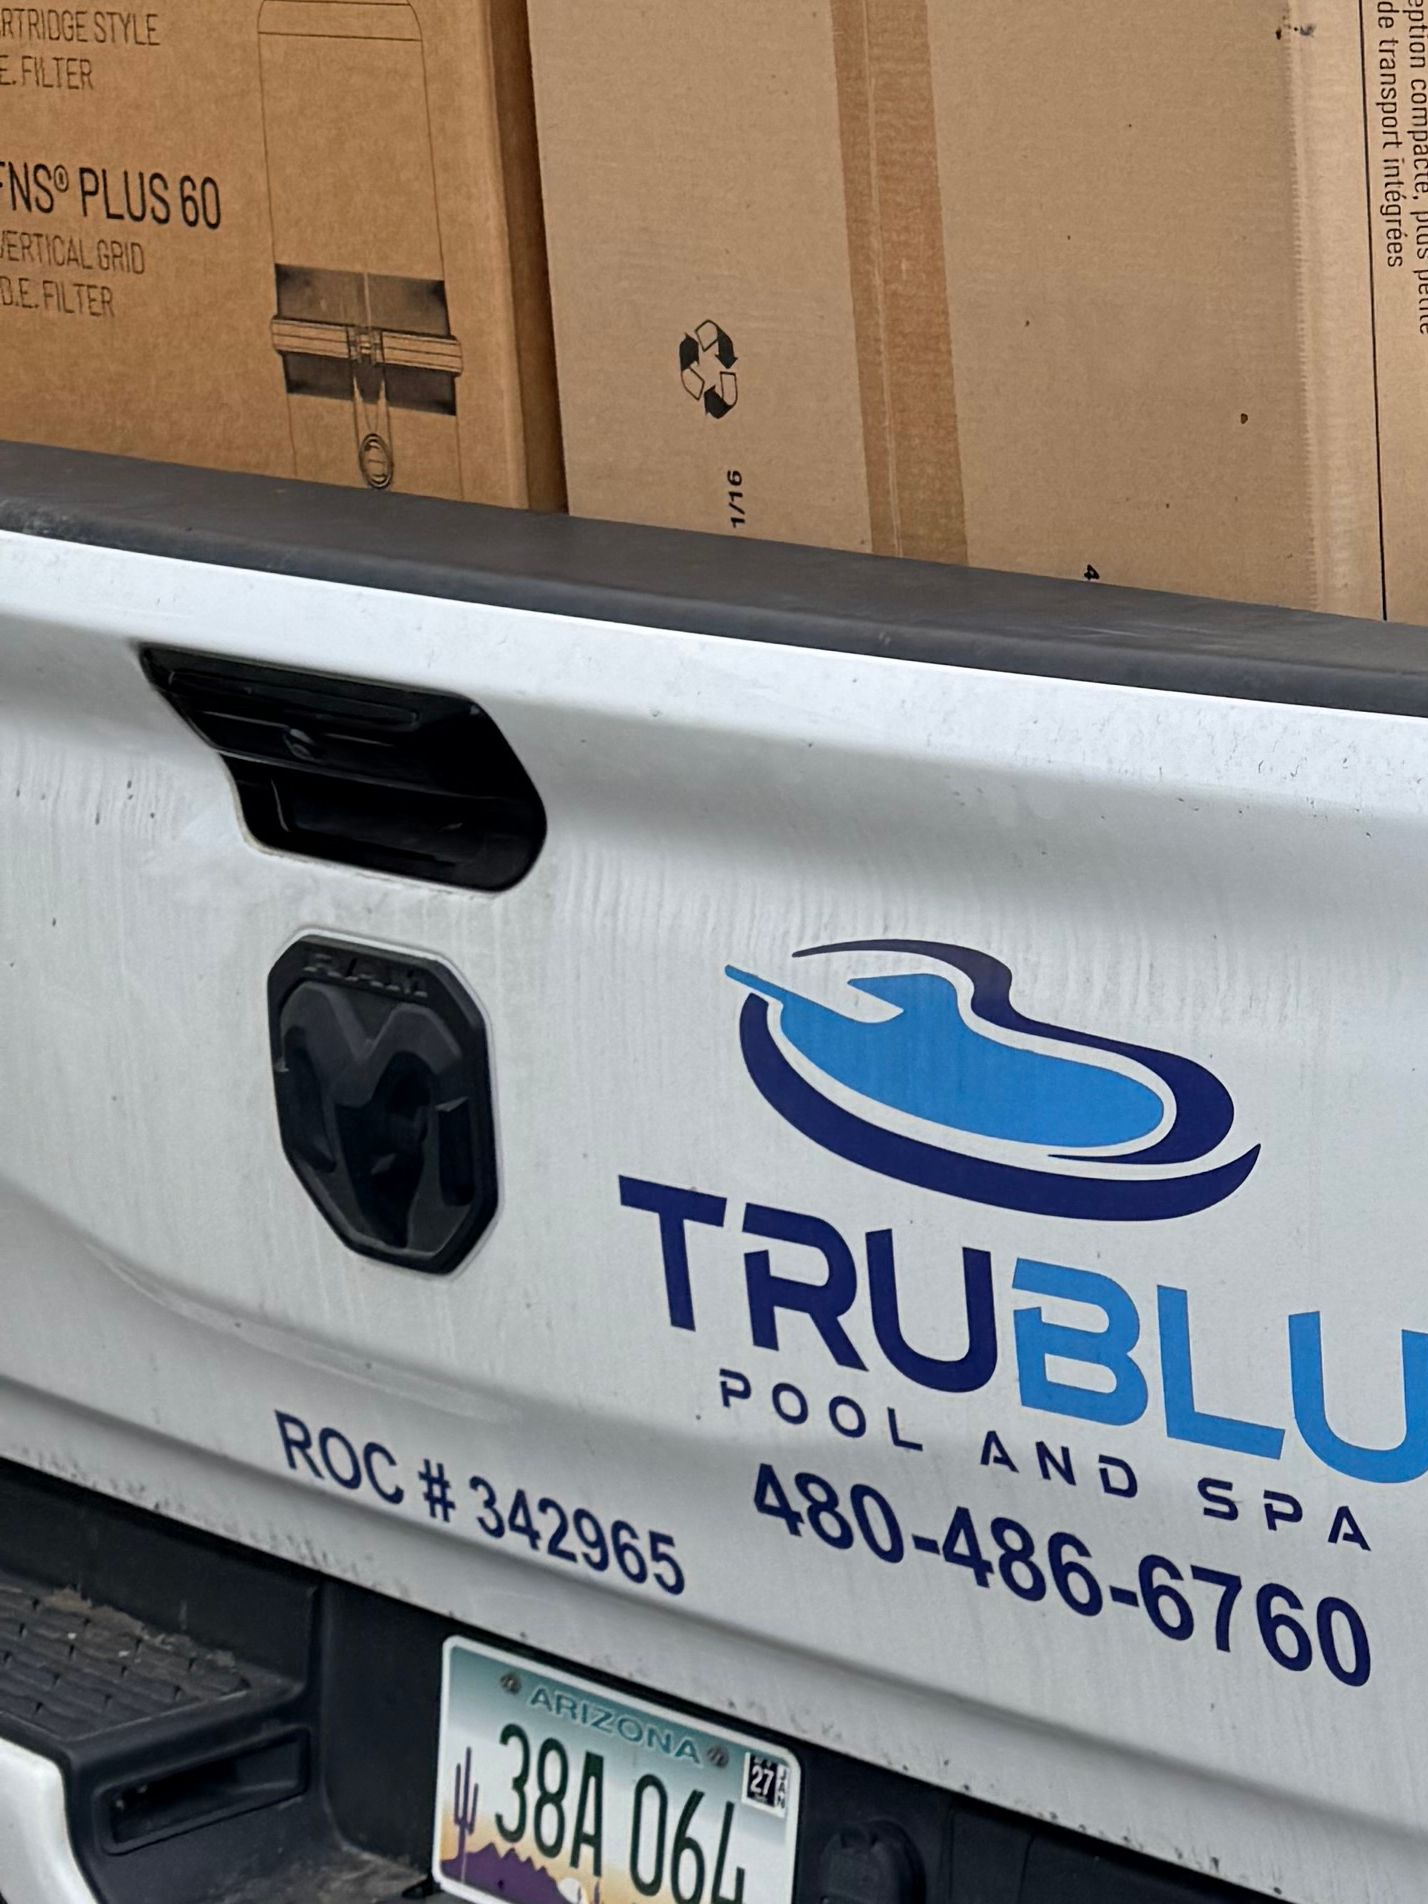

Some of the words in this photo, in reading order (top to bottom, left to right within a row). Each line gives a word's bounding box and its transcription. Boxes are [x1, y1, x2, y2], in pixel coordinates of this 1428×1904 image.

[0, 8, 88, 42] RTRIDGE
[94, 11, 160, 46] STYLE
[1377, 1, 1399, 28] de
[22, 55, 94, 90] FILTER
[1376, 39, 1402, 149] transport
[79, 167, 170, 224] PLUS
[180, 175, 221, 230] 60
[1380, 158, 1407, 267] intégrées
[97, 239, 145, 275] GRID
[43, 280, 115, 318] FILTER
[727, 469, 745, 528] 1/16
[720, 1369, 923, 1451] POOL
[981, 1431, 1137, 1498] AND
[1198, 1478, 1371, 1551] SPA
[275, 1410, 404, 1504] ROC
[419, 1459, 455, 1522] #
[470, 1476, 684, 1595] 342965
[753, 1461, 1372, 1687] 480-486-6760
[529, 1688, 700, 1765] ARIZONA
[495, 1724, 604, 1877] 38A
[750, 1764, 774, 1796] 27
